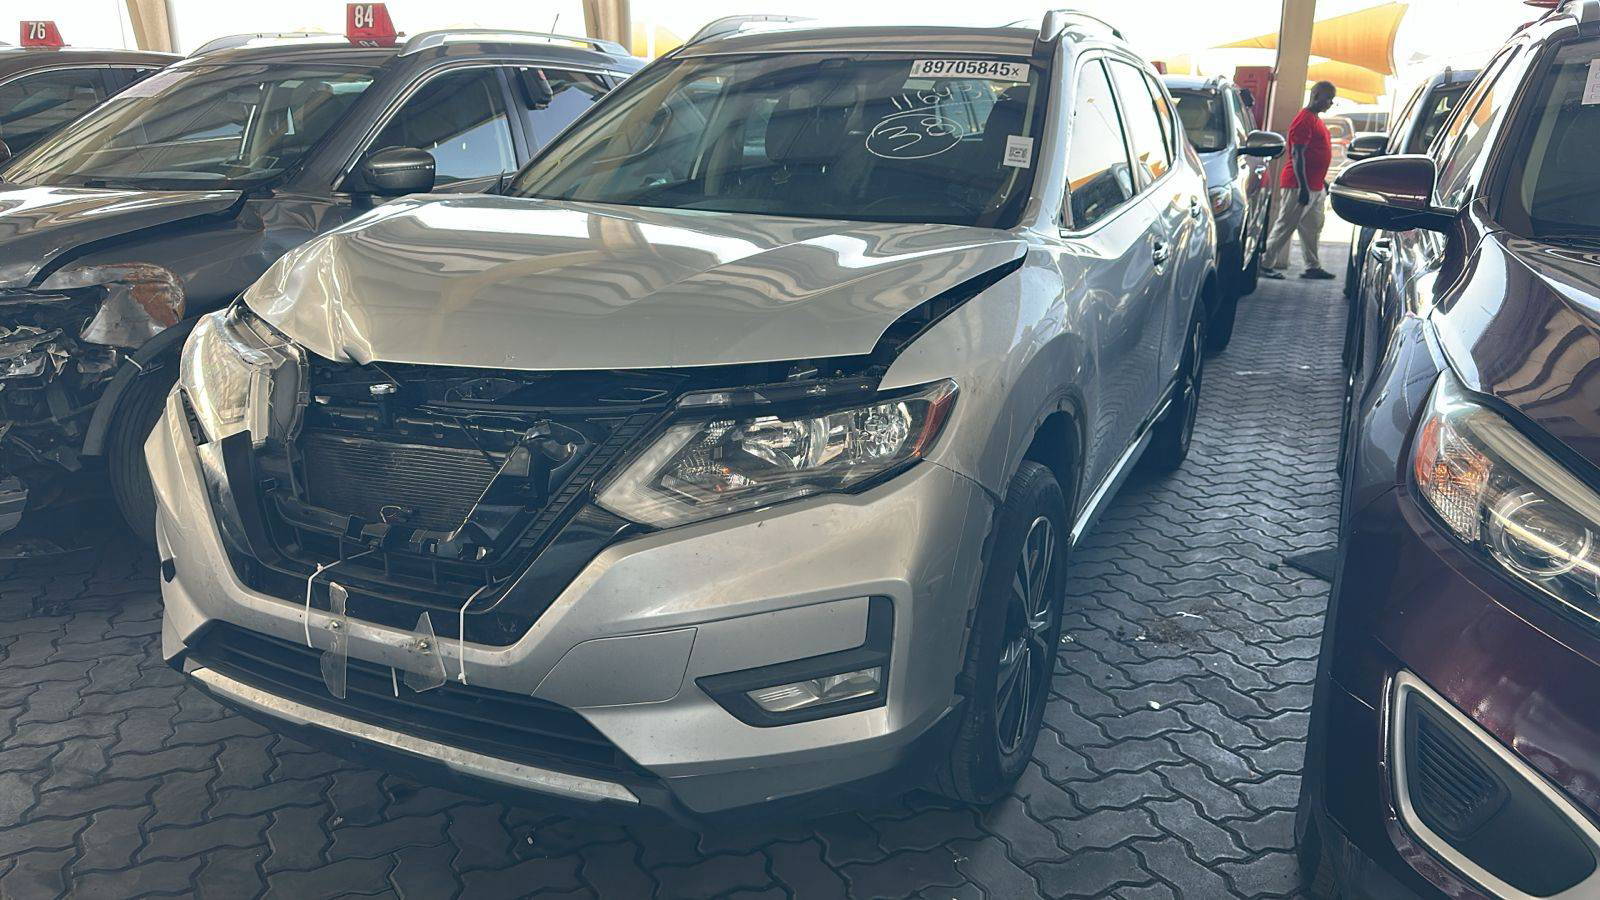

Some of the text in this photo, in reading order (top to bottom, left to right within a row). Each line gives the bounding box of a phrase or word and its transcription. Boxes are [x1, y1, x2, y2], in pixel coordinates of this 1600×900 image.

[355, 5, 374, 28] 84
[29, 22, 46, 40] 76
[876, 117, 957, 152] 38
